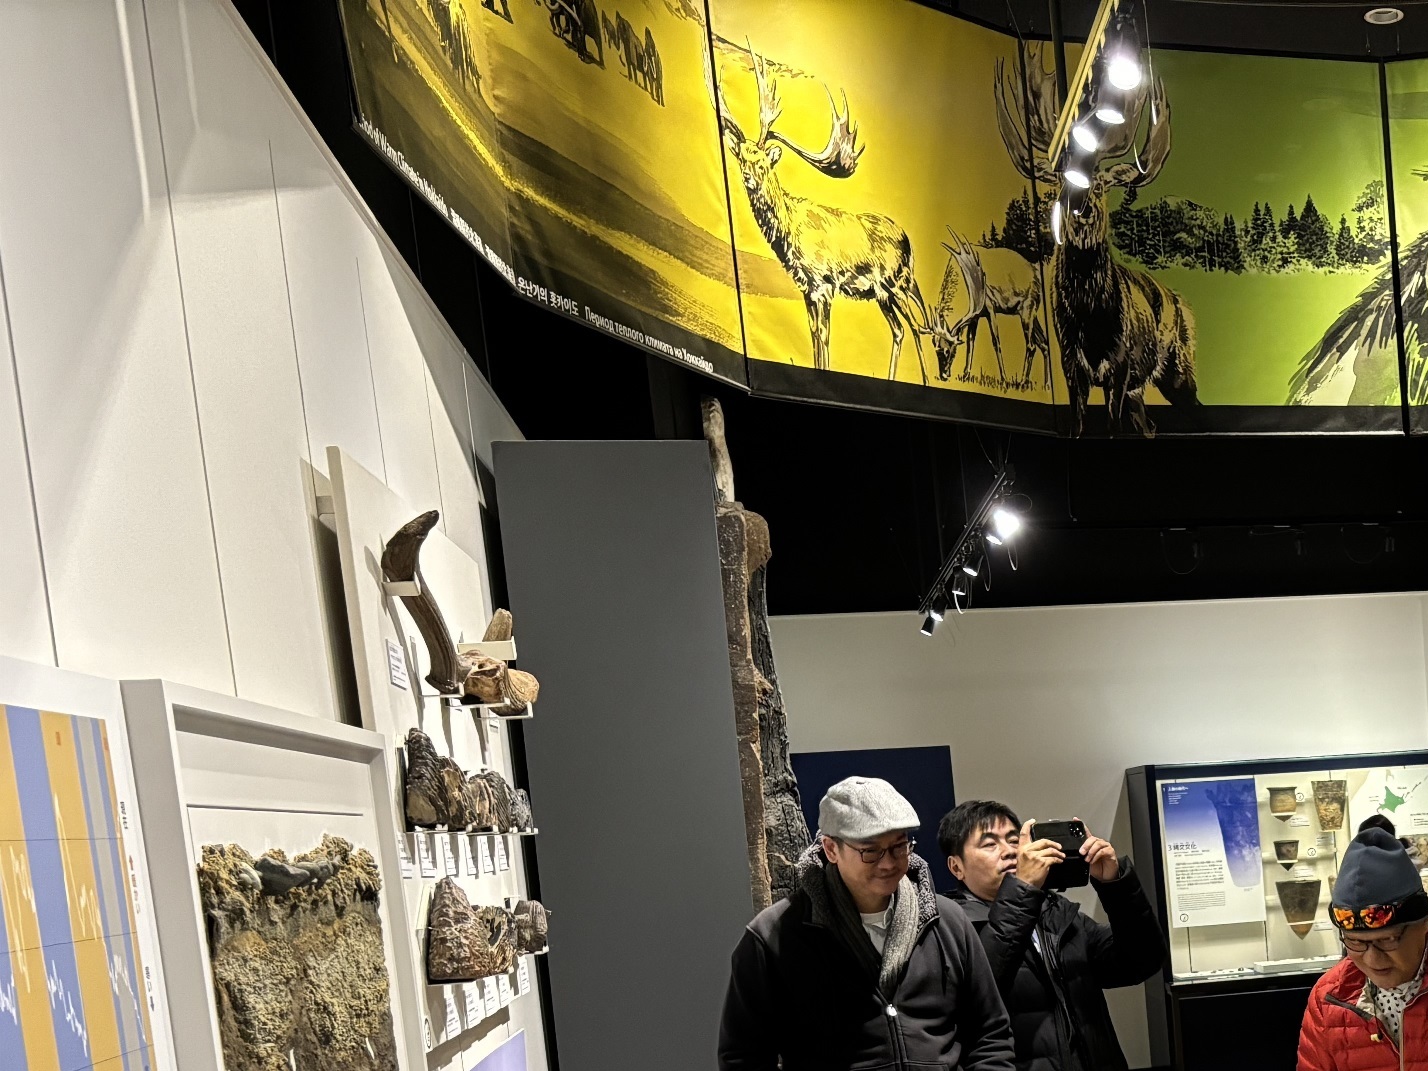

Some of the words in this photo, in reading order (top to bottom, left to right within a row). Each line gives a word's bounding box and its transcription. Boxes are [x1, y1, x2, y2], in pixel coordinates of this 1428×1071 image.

[517, 276, 548, 304] 온난기의
[550, 291, 579, 316] 홋카이도
[584, 305, 615, 333] Период
[614, 323, 644, 344] теплого
[644, 334, 674, 356] климата
[674, 346, 683, 360] на
[682, 347, 714, 373] Хоккайдо
